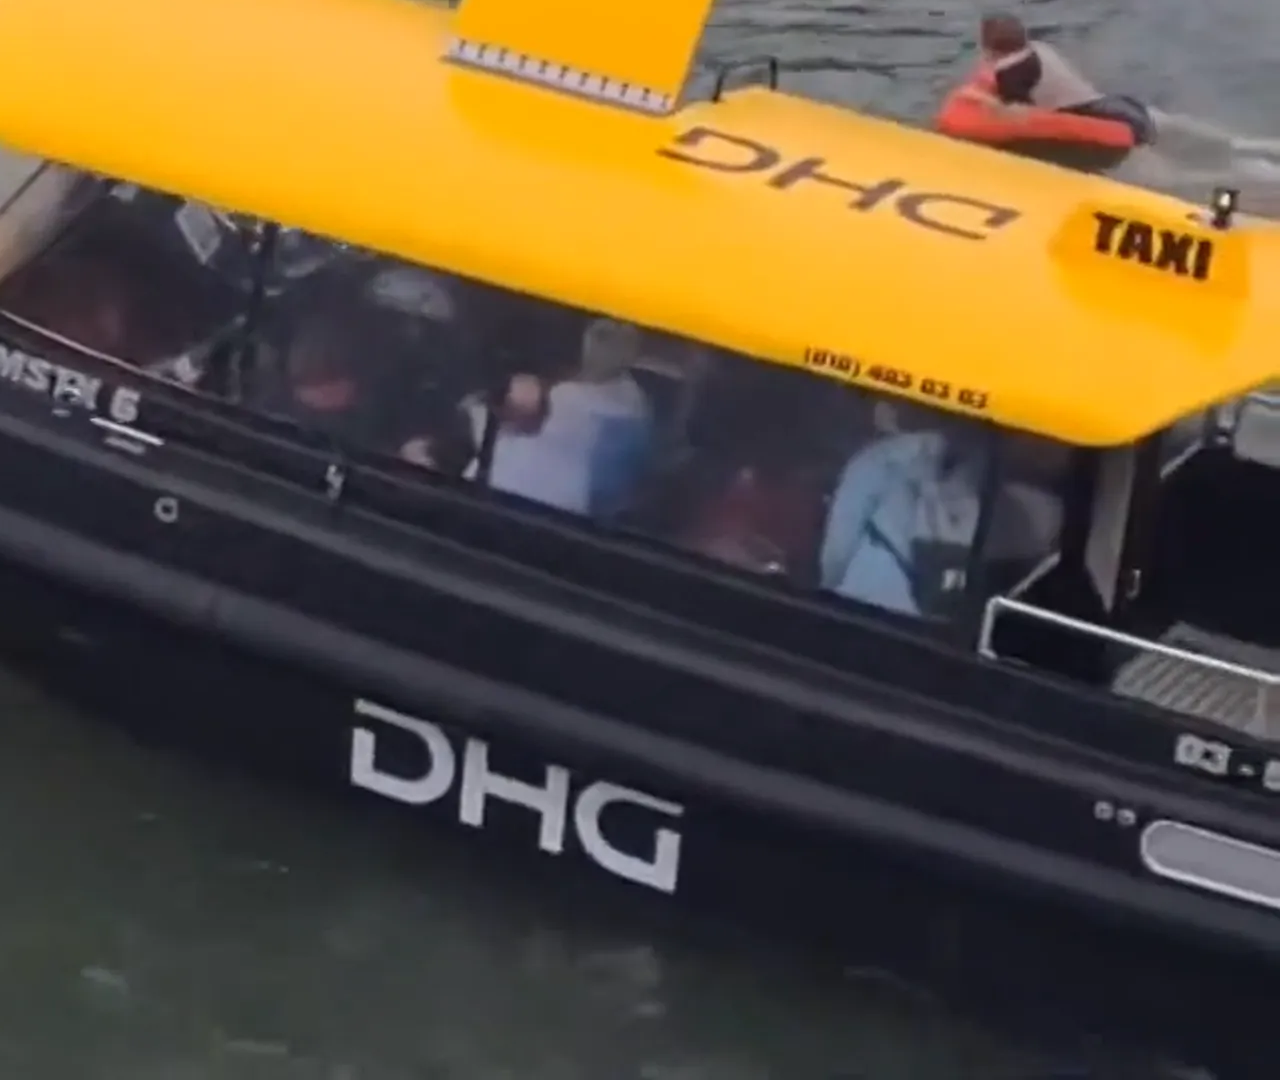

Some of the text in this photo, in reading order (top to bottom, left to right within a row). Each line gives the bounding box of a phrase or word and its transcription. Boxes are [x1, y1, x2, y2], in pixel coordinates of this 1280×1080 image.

[654, 127, 1022, 240] DHG
[1092, 211, 1213, 281] TAXI
[110, 386, 141, 423] 6
[351, 699, 685, 893] DHG
